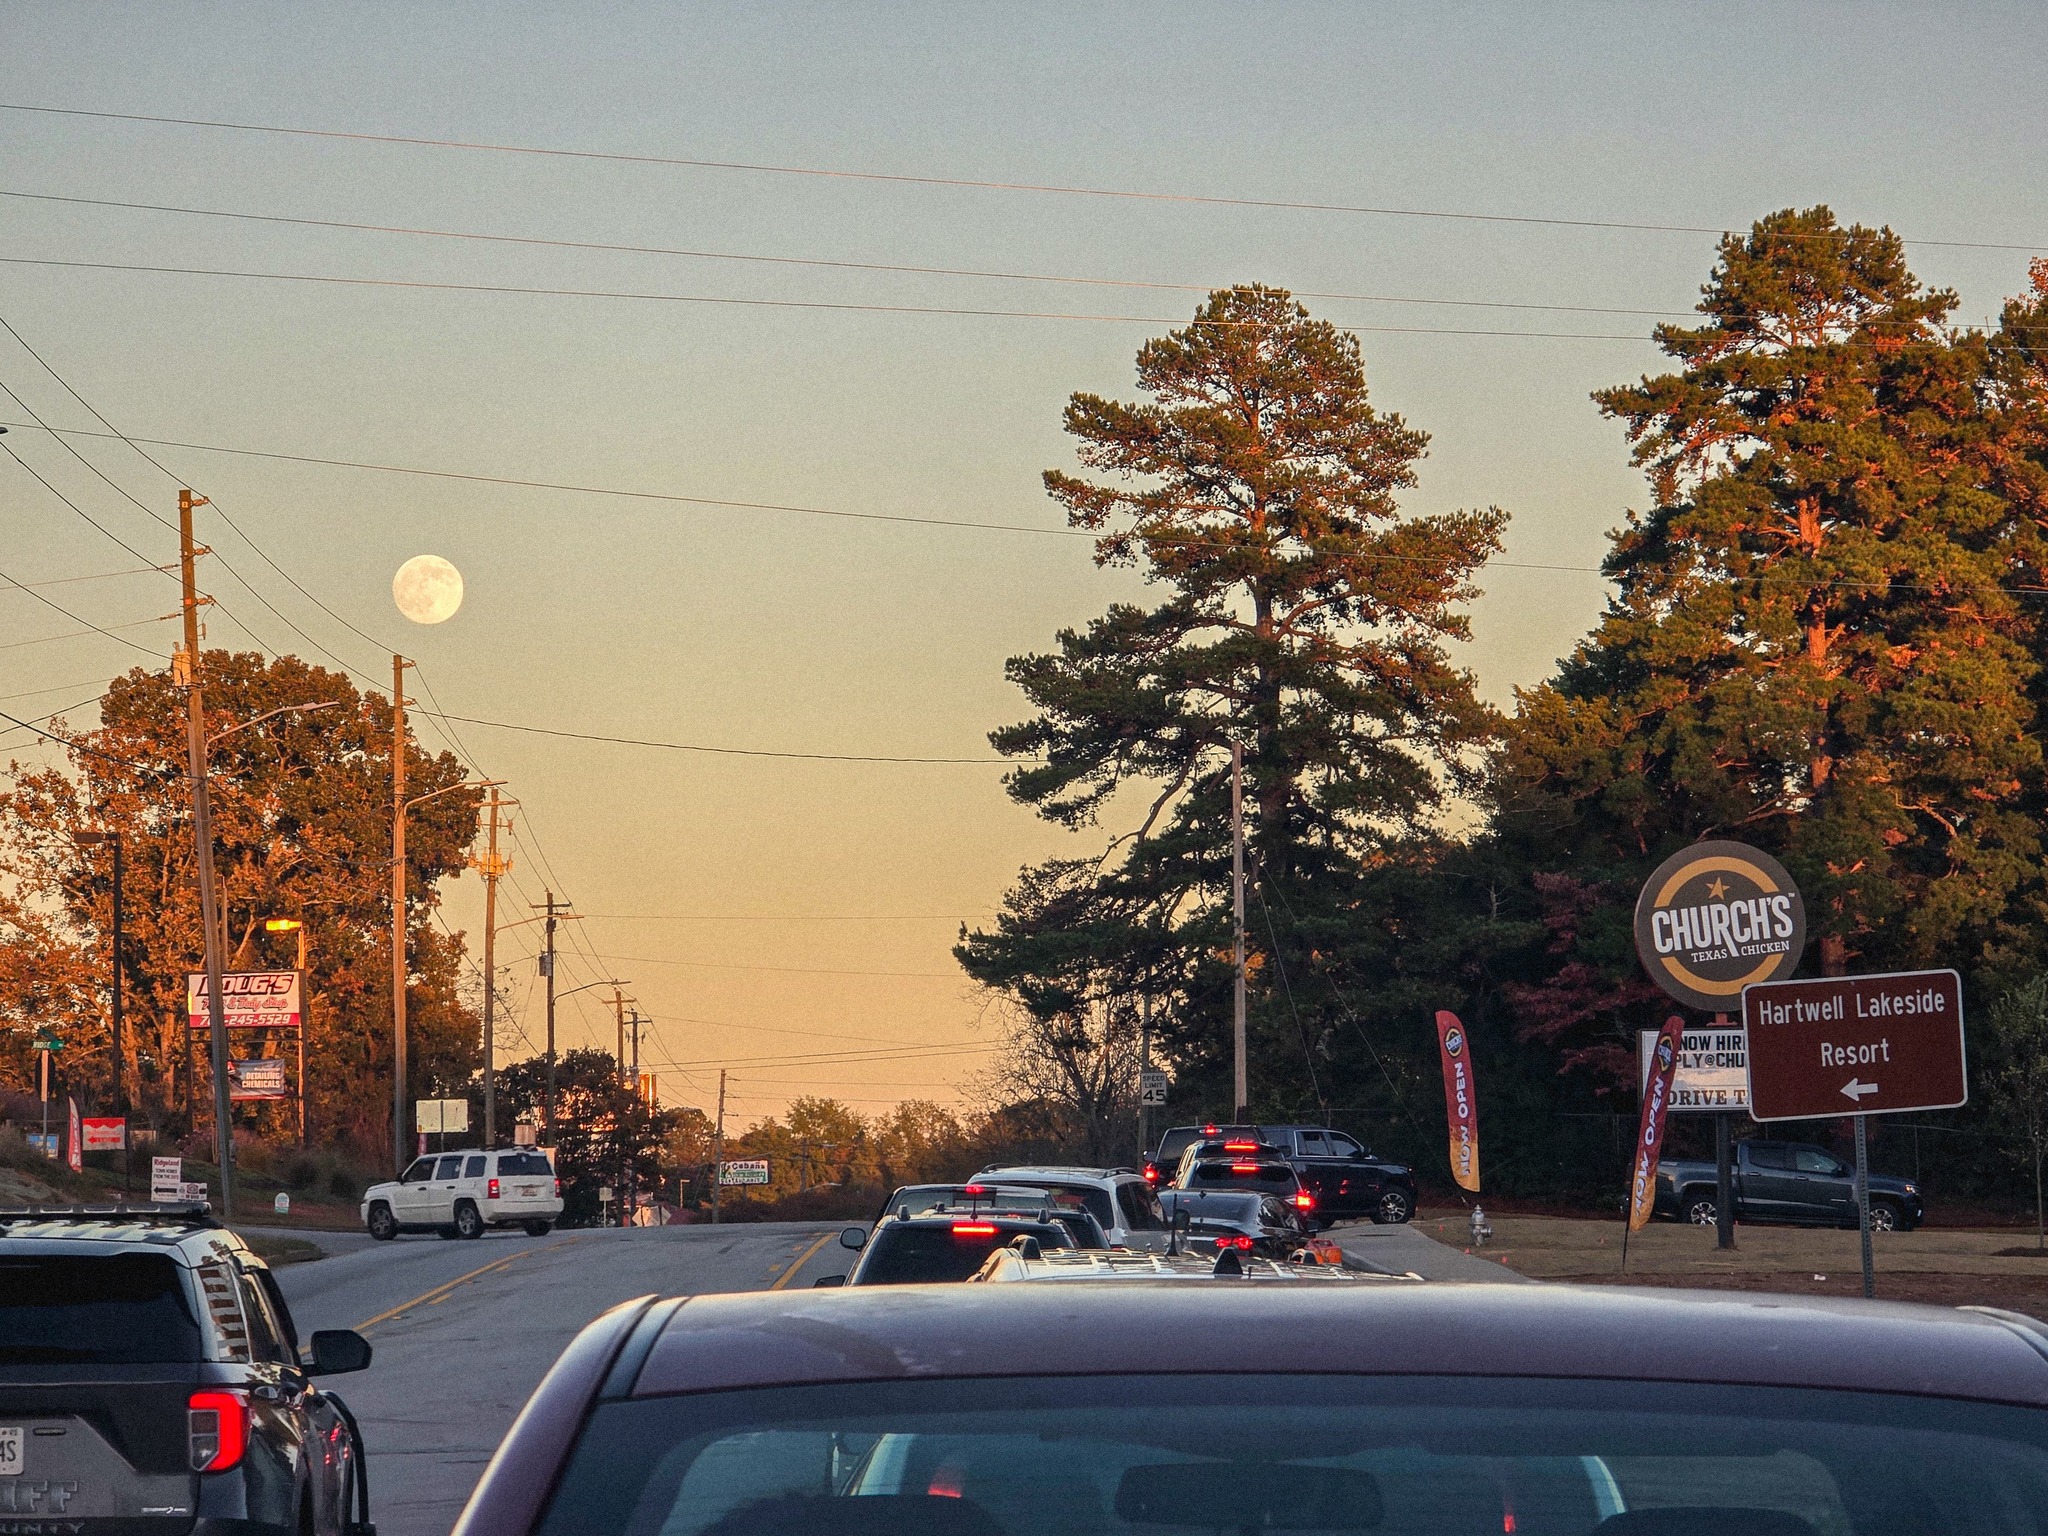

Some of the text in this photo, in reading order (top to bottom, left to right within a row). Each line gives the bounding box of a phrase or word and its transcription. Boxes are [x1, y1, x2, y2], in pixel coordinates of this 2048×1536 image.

[1651, 895, 1793, 957] CHURCH'S
[1691, 940, 1790, 963] TEXAS CHICKEN
[1759, 988, 1945, 1025] Hartwell Lakeside
[200, 1014, 291, 1026] 7-245-5529
[1680, 1035, 1712, 1051] NOW
[1820, 1038, 1890, 1067] Resort
[241, 1080, 280, 1089] CHEMICALS
[1143, 1090, 1165, 1102] 45
[1454, 1061, 1469, 1119] OPEN
[1644, 1075, 1666, 1146] OPEN
[1668, 1090, 1727, 1106] DRIVE
[1459, 1125, 1472, 1176] NOW
